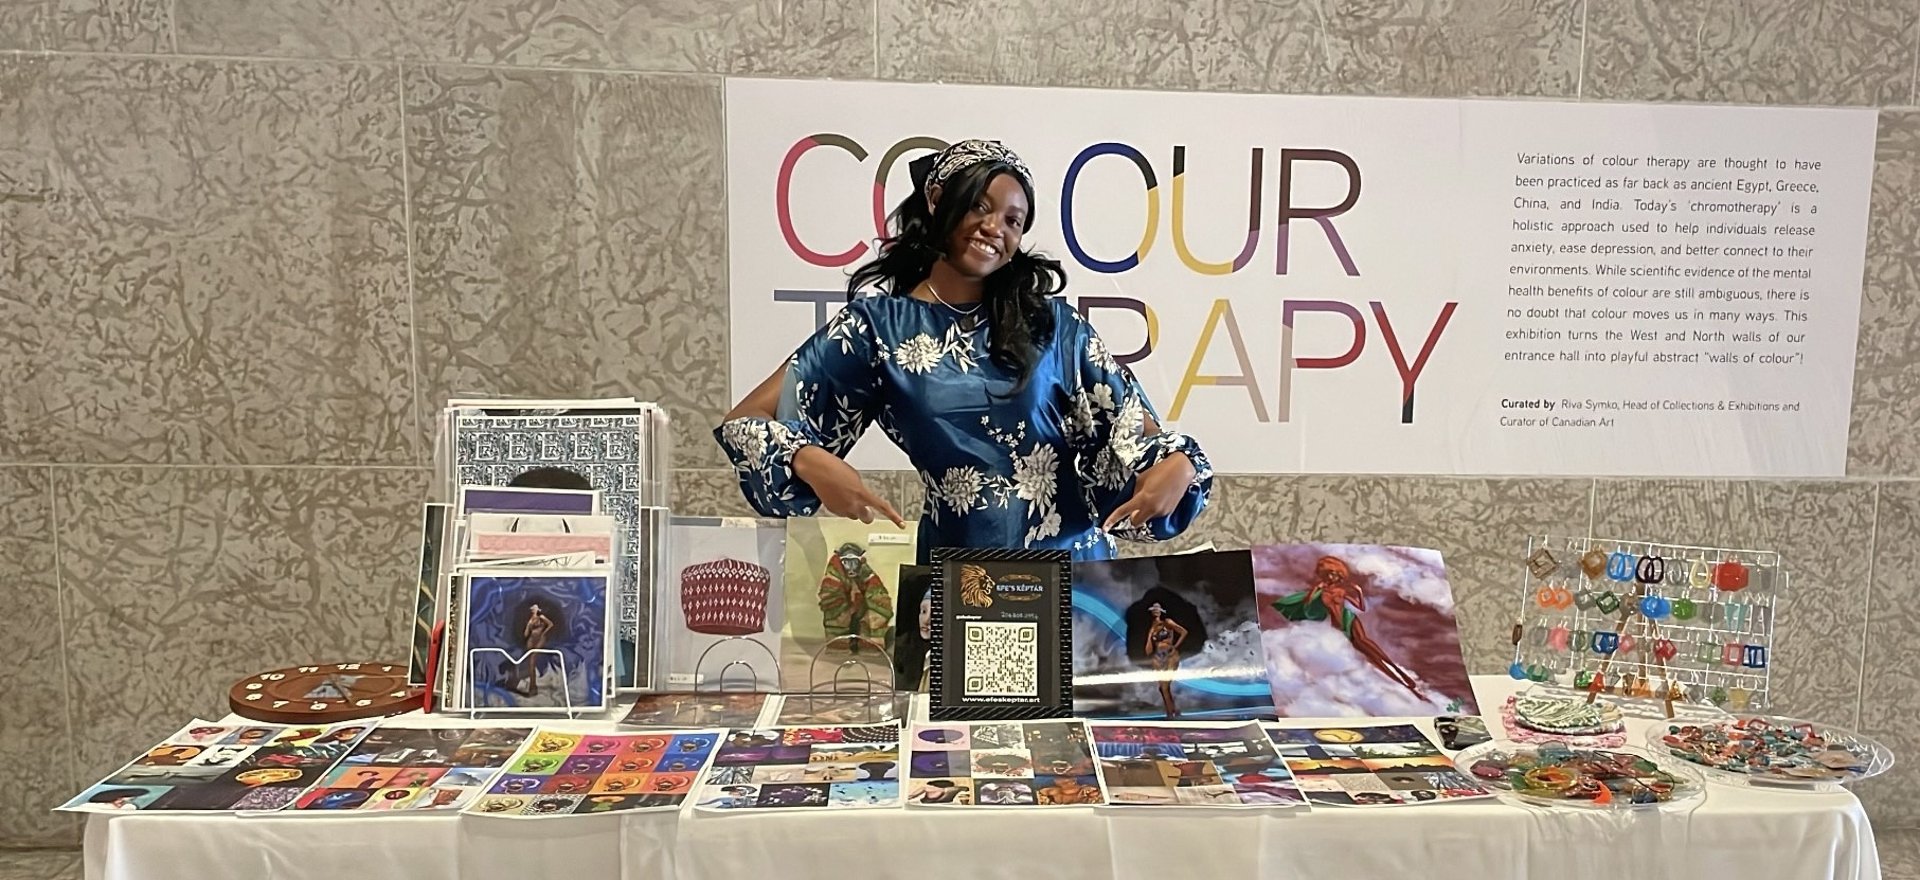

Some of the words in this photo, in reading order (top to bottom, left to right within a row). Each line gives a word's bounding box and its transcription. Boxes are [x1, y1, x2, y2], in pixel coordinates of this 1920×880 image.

[1517, 152, 1575, 165] Variations
[1582, 154, 1595, 166] of
[1602, 154, 1639, 166] colour
[1647, 155, 1690, 171] therapy
[1697, 159, 1716, 168] are
[1724, 157, 1767, 172] thought
[1776, 158, 1786, 170] to
[1794, 158, 1821, 170] have
[1515, 175, 1544, 187] been
[1548, 176, 1601, 190] practiced
[1605, 180, 1618, 188] as
[1623, 176, 1639, 189] far
[1643, 178, 1669, 189] back
[1673, 180, 1686, 190] as
[1690, 179, 1732, 191] ancient
[1736, 178, 1772, 194] Egypt,
[1776, 180, 1819, 193] Greece,
[1514, 196, 1549, 210] China,
[1560, 198, 1581, 210] and
[1592, 198, 1622, 210] India.
[1791, 202, 1800, 214] is
[1810, 205, 1817, 214] a
[1512, 219, 1554, 231] holistic
[1561, 221, 1614, 234] approach
[1622, 221, 1650, 232] used
[1657, 222, 1668, 233] to
[1675, 222, 1699, 236] help
[1706, 222, 1767, 235] individuals
[1774, 224, 1815, 236] release
[1510, 242, 1555, 256] anxiety,
[1560, 244, 1587, 254] ease
[1590, 242, 1656, 256] depression,
[1660, 244, 1682, 255] and
[1686, 243, 1720, 256] better
[1724, 246, 1768, 256] connect
[1772, 246, 1784, 257] to
[1788, 245, 1814, 258] their
[1510, 264, 1590, 275] environments.
[1596, 264, 1627, 276] While
[1630, 265, 1681, 277] scientific
[1684, 266, 1735, 278] evidence
[1738, 266, 1749, 278] of
[1752, 267, 1770, 278] the
[1773, 268, 1811, 279] mental
[1508, 284, 1544, 296] health
[1548, 285, 1594, 297] benefits
[1597, 286, 1608, 298] of
[1612, 286, 1648, 298] colour
[1652, 290, 1671, 298] are
[1674, 288, 1694, 299] still
[1698, 288, 1762, 302] ambiguous,
[1767, 288, 1796, 300] there
[1800, 289, 1810, 300] is
[1507, 309, 1522, 318] no
[1526, 307, 1559, 318] doubt
[1565, 308, 1586, 318] that
[1591, 307, 1628, 319] colour
[1632, 310, 1670, 320] moves
[1675, 312, 1688, 320] us
[1694, 308, 1704, 320] in
[1709, 312, 1740, 323] many
[1745, 312, 1777, 324] ways.
[1784, 310, 1808, 322] This
[1506, 328, 1561, 340] exhibition
[1568, 330, 1598, 340] turns
[1605, 330, 1623, 340] the
[1630, 329, 1658, 341] West
[1664, 330, 1686, 342] and
[1693, 330, 1725, 342] North
[1732, 331, 1762, 342] walls
[1768, 331, 1780, 342] of
[1786, 334, 1806, 343] our
[1504, 350, 1555, 361] entrance
[1560, 350, 1580, 361] hall
[1584, 350, 1606, 362] into
[1610, 350, 1648, 365] playful
[1653, 352, 1699, 363] abstract
[1743, 352, 1755, 363] of
[1501, 398, 1540, 409] Curated
[1544, 399, 1556, 412] by
[1562, 399, 1582, 409] Riva
[1622, 400, 1648, 410] Head
[1650, 400, 1660, 410] of
[1662, 400, 1714, 410] Collections
[1728, 400, 1780, 412] Exhibitions
[1782, 401, 1800, 412] and
[1500, 416, 1536, 426] Curator
[1539, 416, 1549, 427] of
[1552, 416, 1596, 427] Canadian
[1598, 417, 1614, 427] Art
